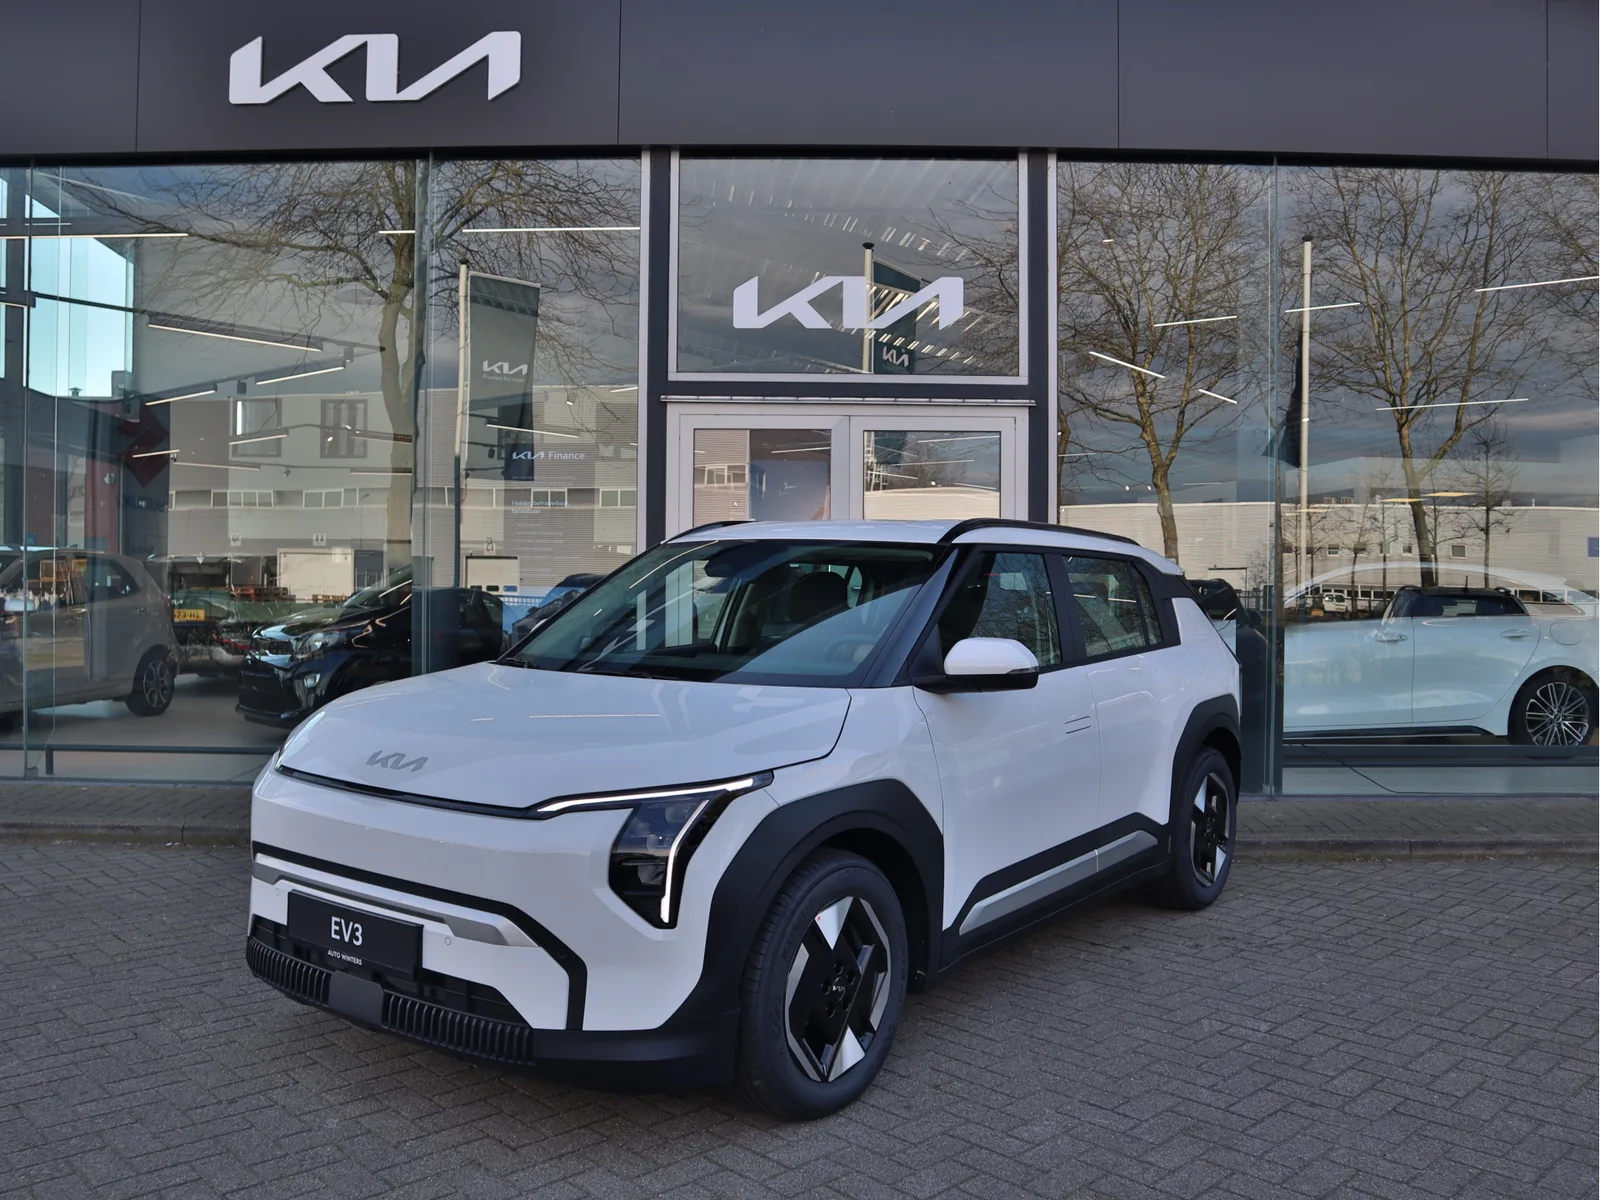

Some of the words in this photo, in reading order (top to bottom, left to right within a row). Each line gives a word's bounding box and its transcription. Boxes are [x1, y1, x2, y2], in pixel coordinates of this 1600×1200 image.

[229, 31, 521, 104] KIA
[733, 275, 964, 330] KIA
[482, 359, 529, 376] KIA
[883, 346, 909, 368] KIA
[512, 451, 545, 460] KIA
[548, 451, 585, 460] Finance
[365, 750, 429, 773] KIA
[330, 915, 363, 946] EV3
[327, 949, 341, 959] AUTO
[341, 953, 363, 966] WINTERS
